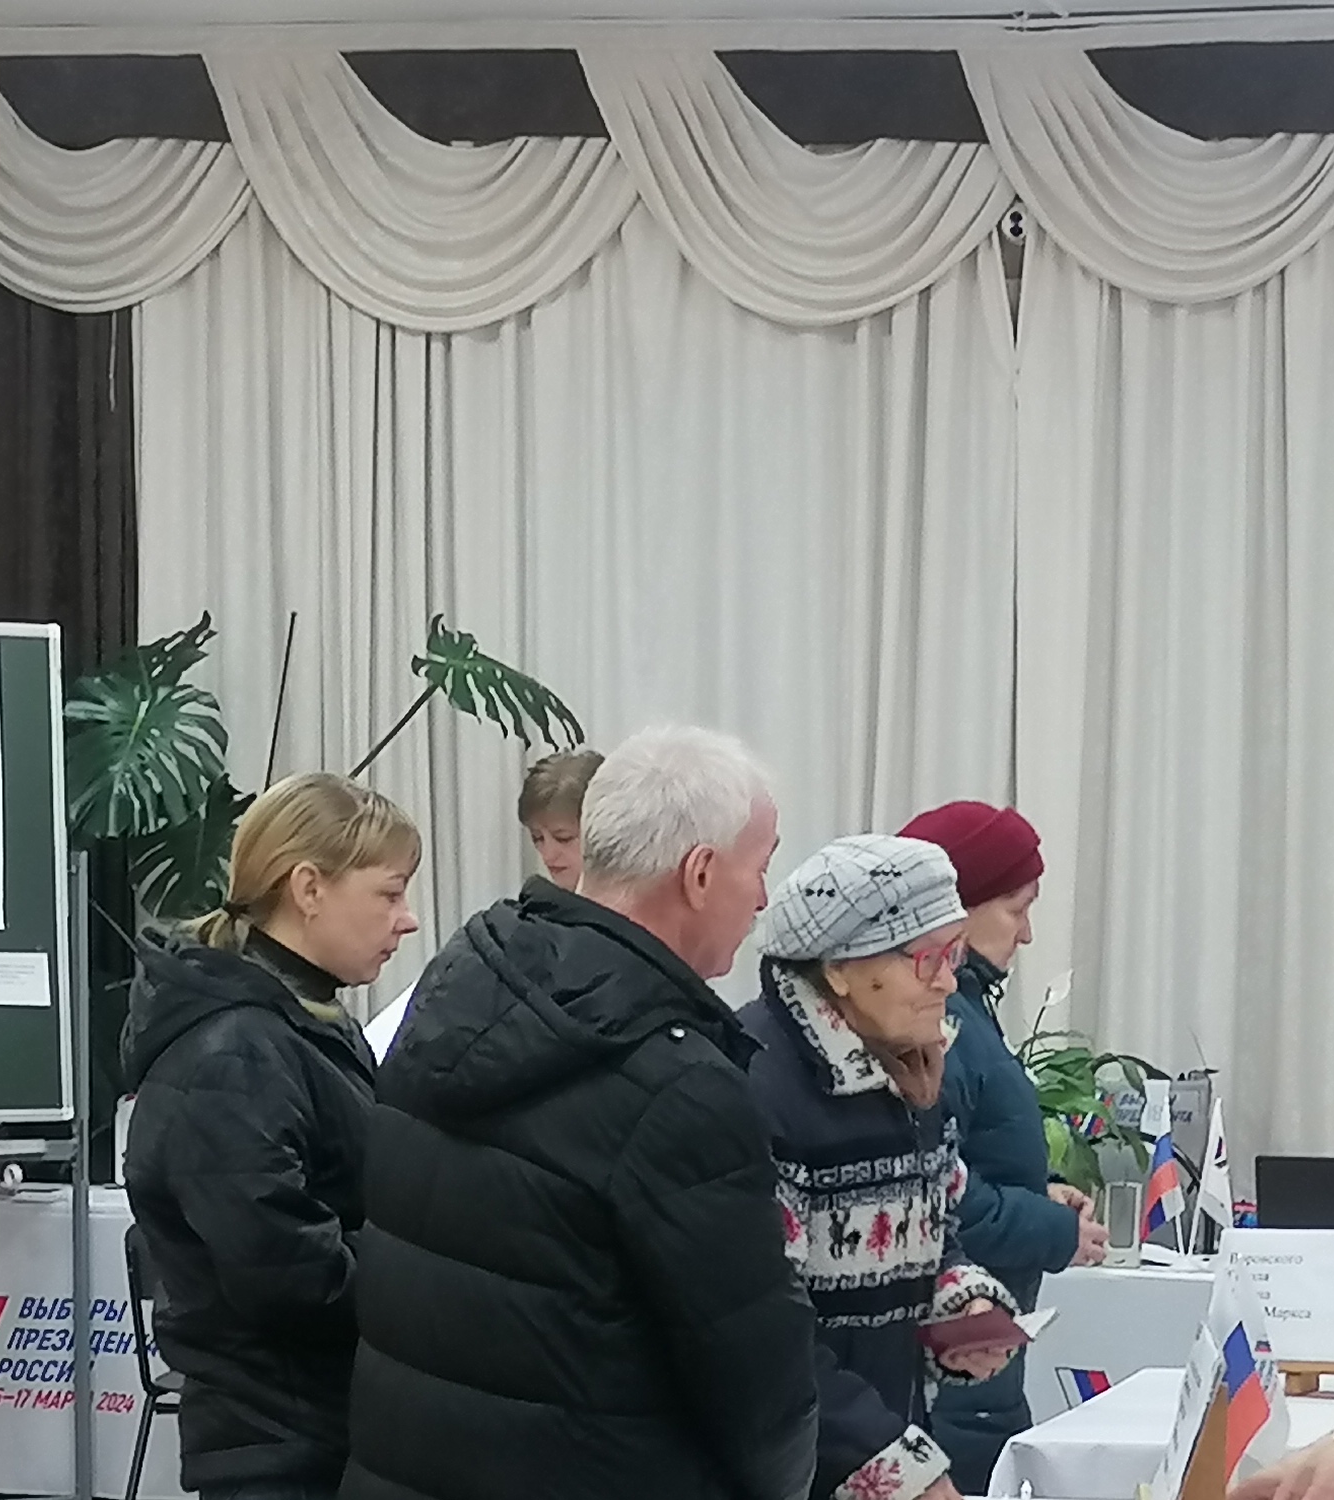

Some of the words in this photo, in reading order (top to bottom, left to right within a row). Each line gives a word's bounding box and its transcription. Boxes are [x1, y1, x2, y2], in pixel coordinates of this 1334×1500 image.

[18, 1297, 128, 1323] ВЫБРЫ
[1264, 1305, 1311, 1322] Маркса
[95, 1391, 135, 1413] 2024
